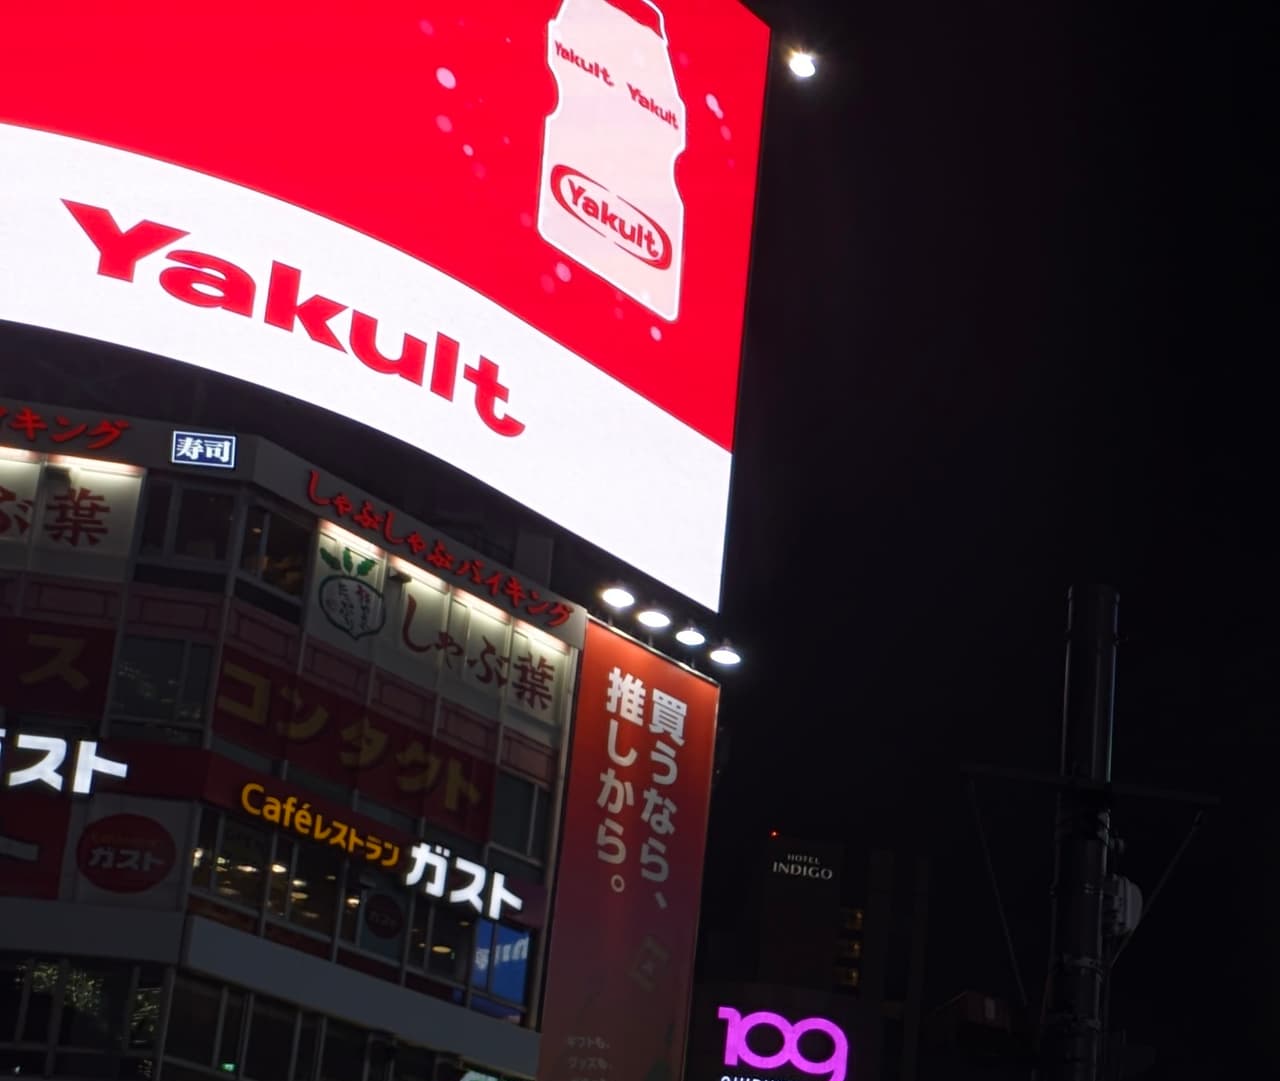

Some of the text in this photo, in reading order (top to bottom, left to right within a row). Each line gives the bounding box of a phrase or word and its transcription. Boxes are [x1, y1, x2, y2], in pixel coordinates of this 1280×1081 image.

[554, 39, 614, 87] Yakult
[627, 81, 679, 130] Yakult
[568, 177, 663, 258] Yakult
[60, 198, 525, 437] Yakult
[0, 407, 131, 450] キング
[176, 437, 234, 464] 寿司
[306, 470, 575, 629] しゃぶしゃぶバイキング
[402, 594, 557, 712] しゃぶ葉
[0, 728, 128, 795] スト
[216, 661, 482, 812] コンタクト
[596, 666, 646, 894] 推しから。
[639, 687, 688, 910] 買うなら、
[87, 845, 165, 873] ガスト
[405, 839, 524, 922] ガスト
[772, 860, 834, 881] INDIGO
[786, 852, 821, 866] HOTEL
